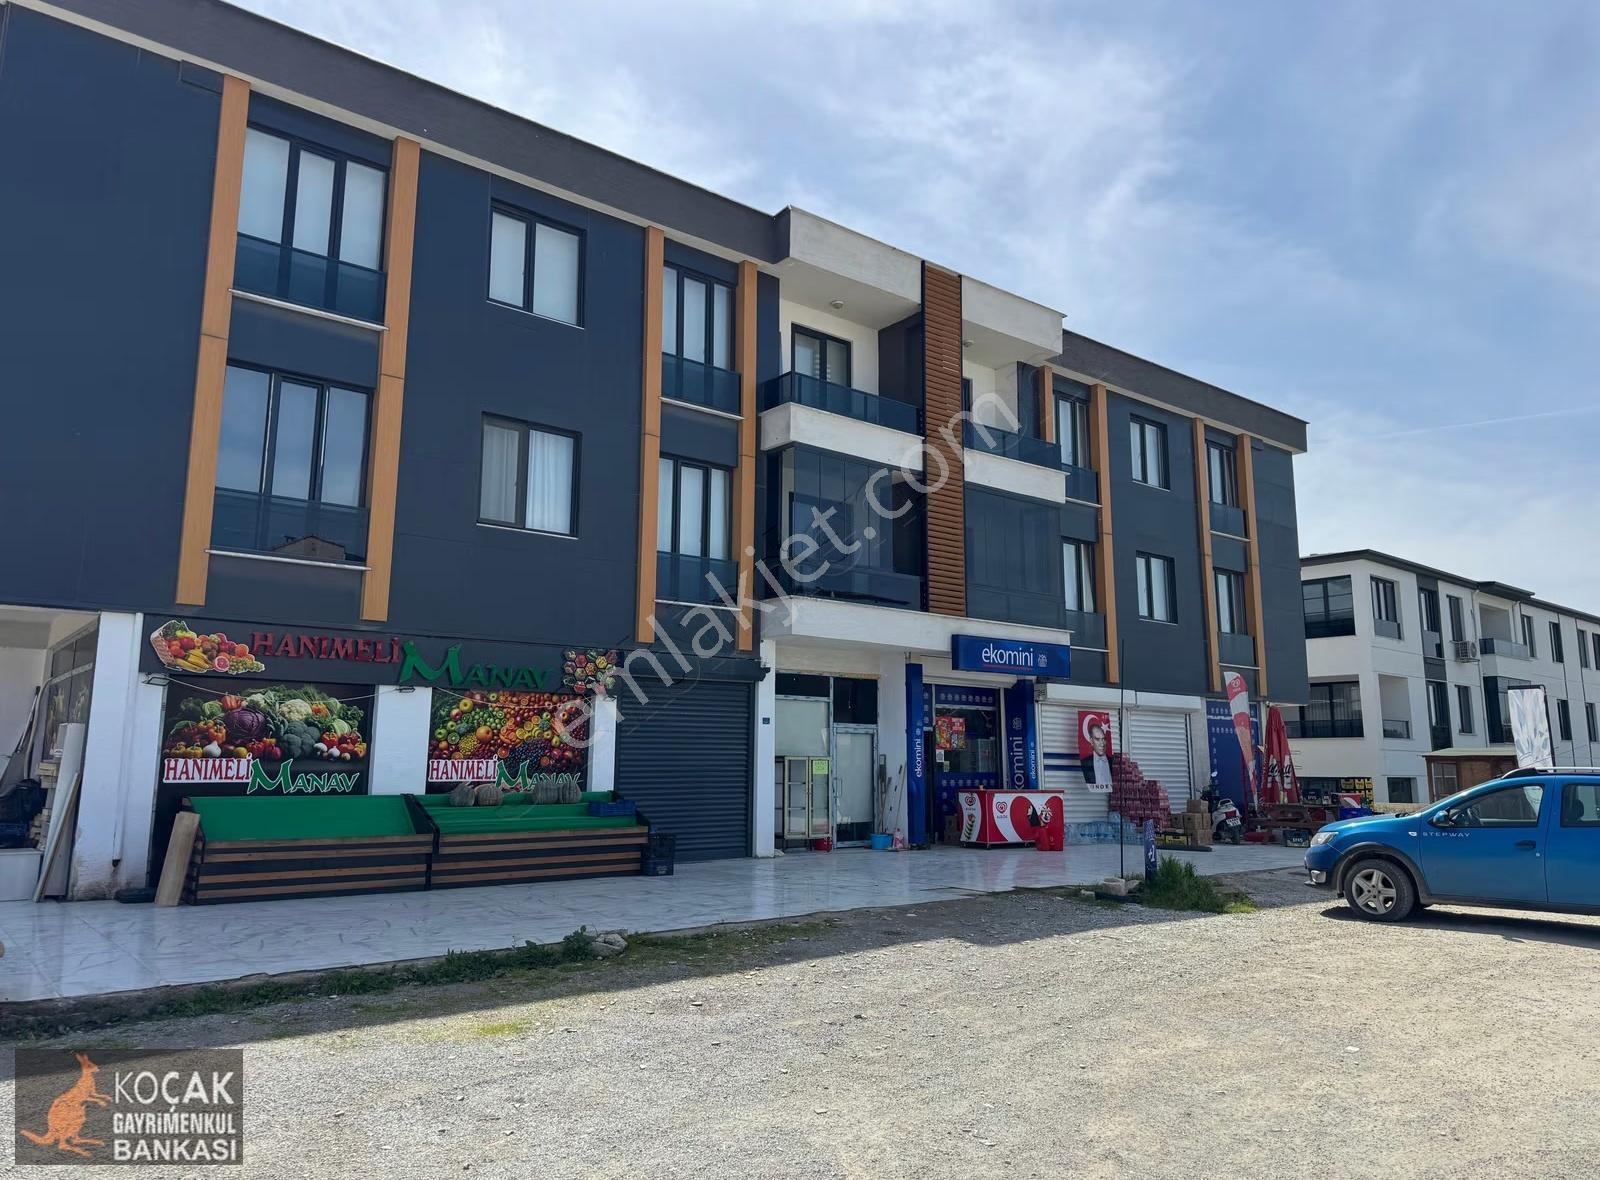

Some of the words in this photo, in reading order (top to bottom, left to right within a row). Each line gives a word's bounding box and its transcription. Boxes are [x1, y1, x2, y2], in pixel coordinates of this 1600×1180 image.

[252, 631, 399, 663] HANIMELİ
[399, 640, 550, 688] MANAV
[982, 643, 1034, 667] ekomini
[165, 753, 251, 781] HANIMELİ
[248, 759, 359, 794] MANAV
[429, 754, 498, 780] HANIMELİ
[914, 738, 922, 778] ekomini
[1010, 736, 1024, 790] komini
